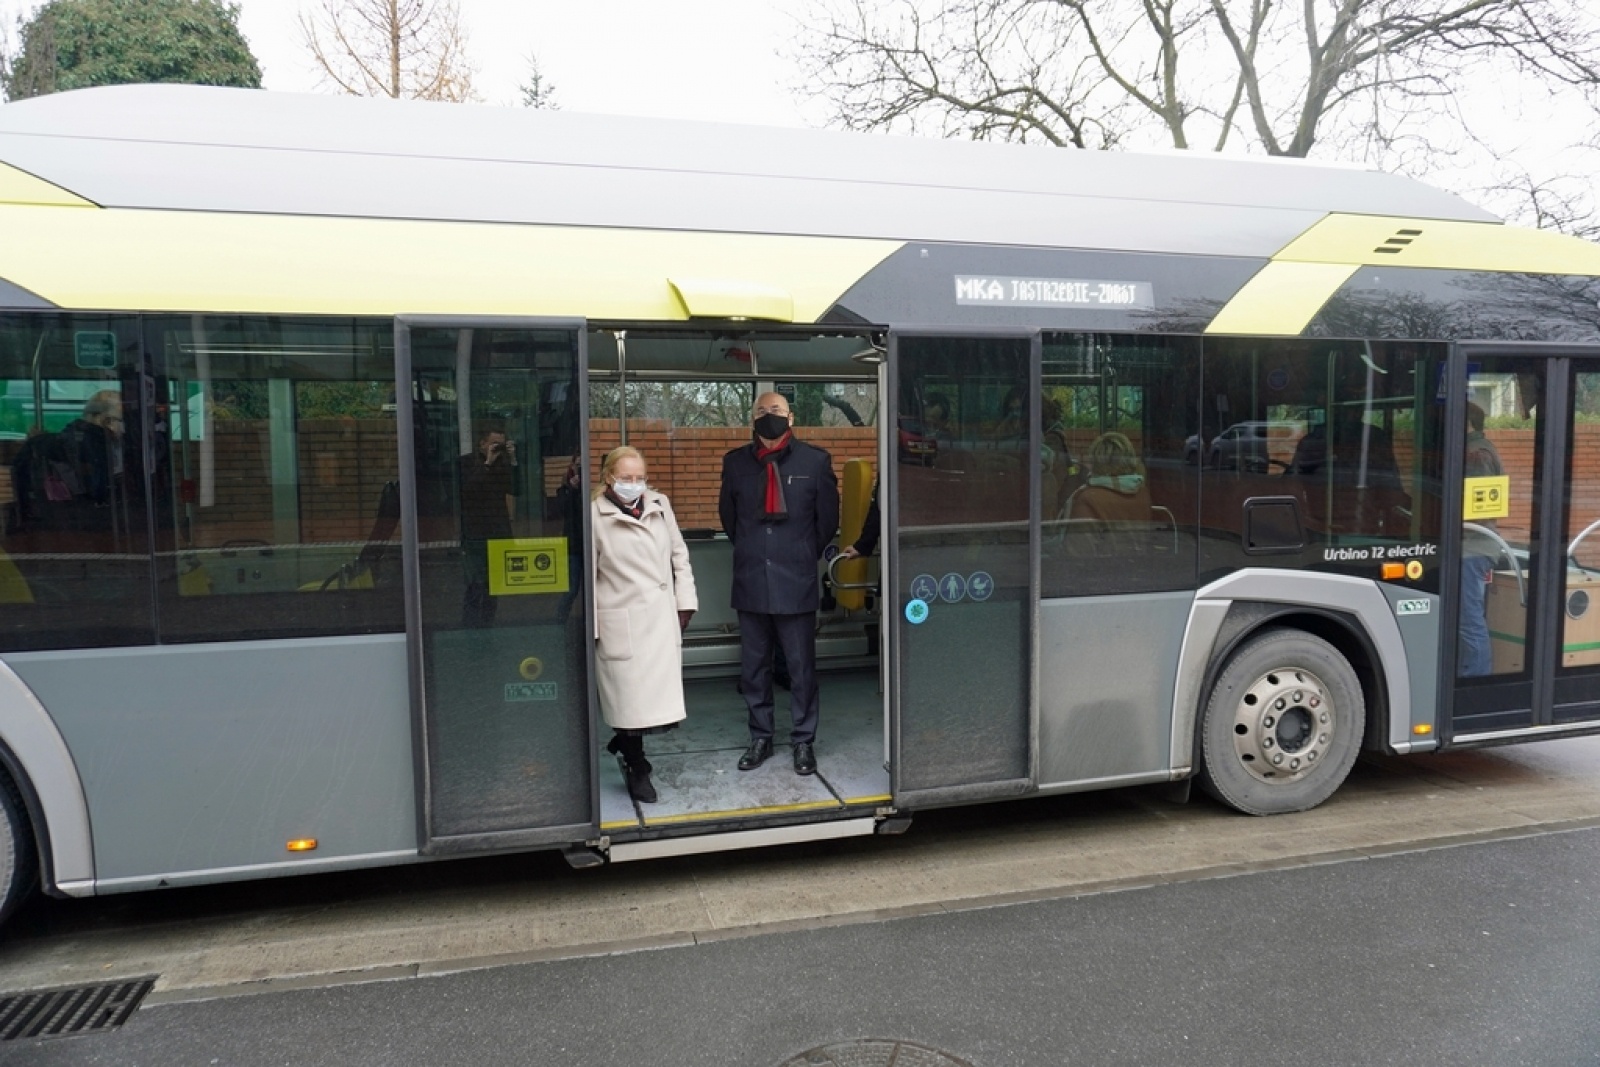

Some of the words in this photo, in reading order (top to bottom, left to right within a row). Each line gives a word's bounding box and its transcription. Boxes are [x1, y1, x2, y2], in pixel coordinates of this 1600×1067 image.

[956, 278, 1003, 300] MKA
[1324, 547, 1368, 560] Urbino
[1371, 546, 1384, 558] 12
[1387, 543, 1437, 558] electric
